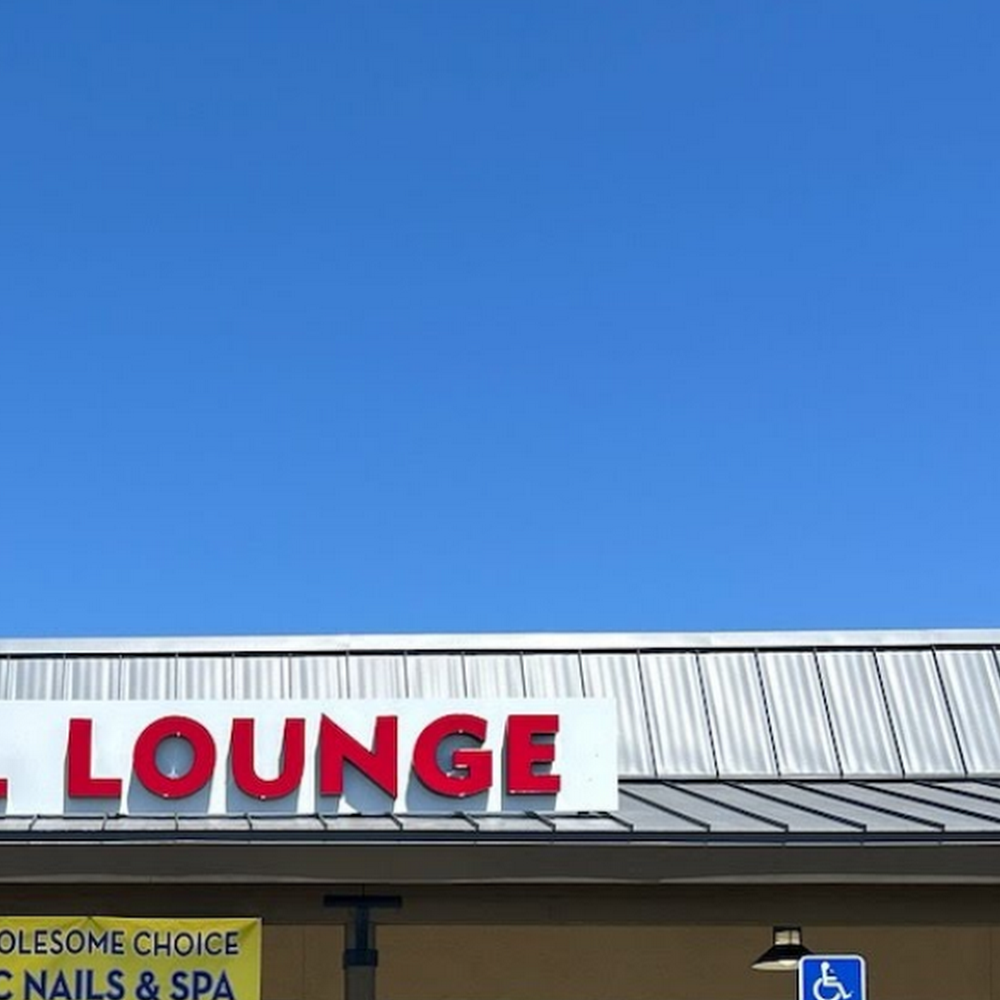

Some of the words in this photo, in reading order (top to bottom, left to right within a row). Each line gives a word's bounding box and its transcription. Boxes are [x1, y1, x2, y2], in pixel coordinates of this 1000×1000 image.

[67, 712, 561, 800] LOUNGE
[133, 931, 240, 956] CHOICE
[24, 969, 125, 1000] NAILS
